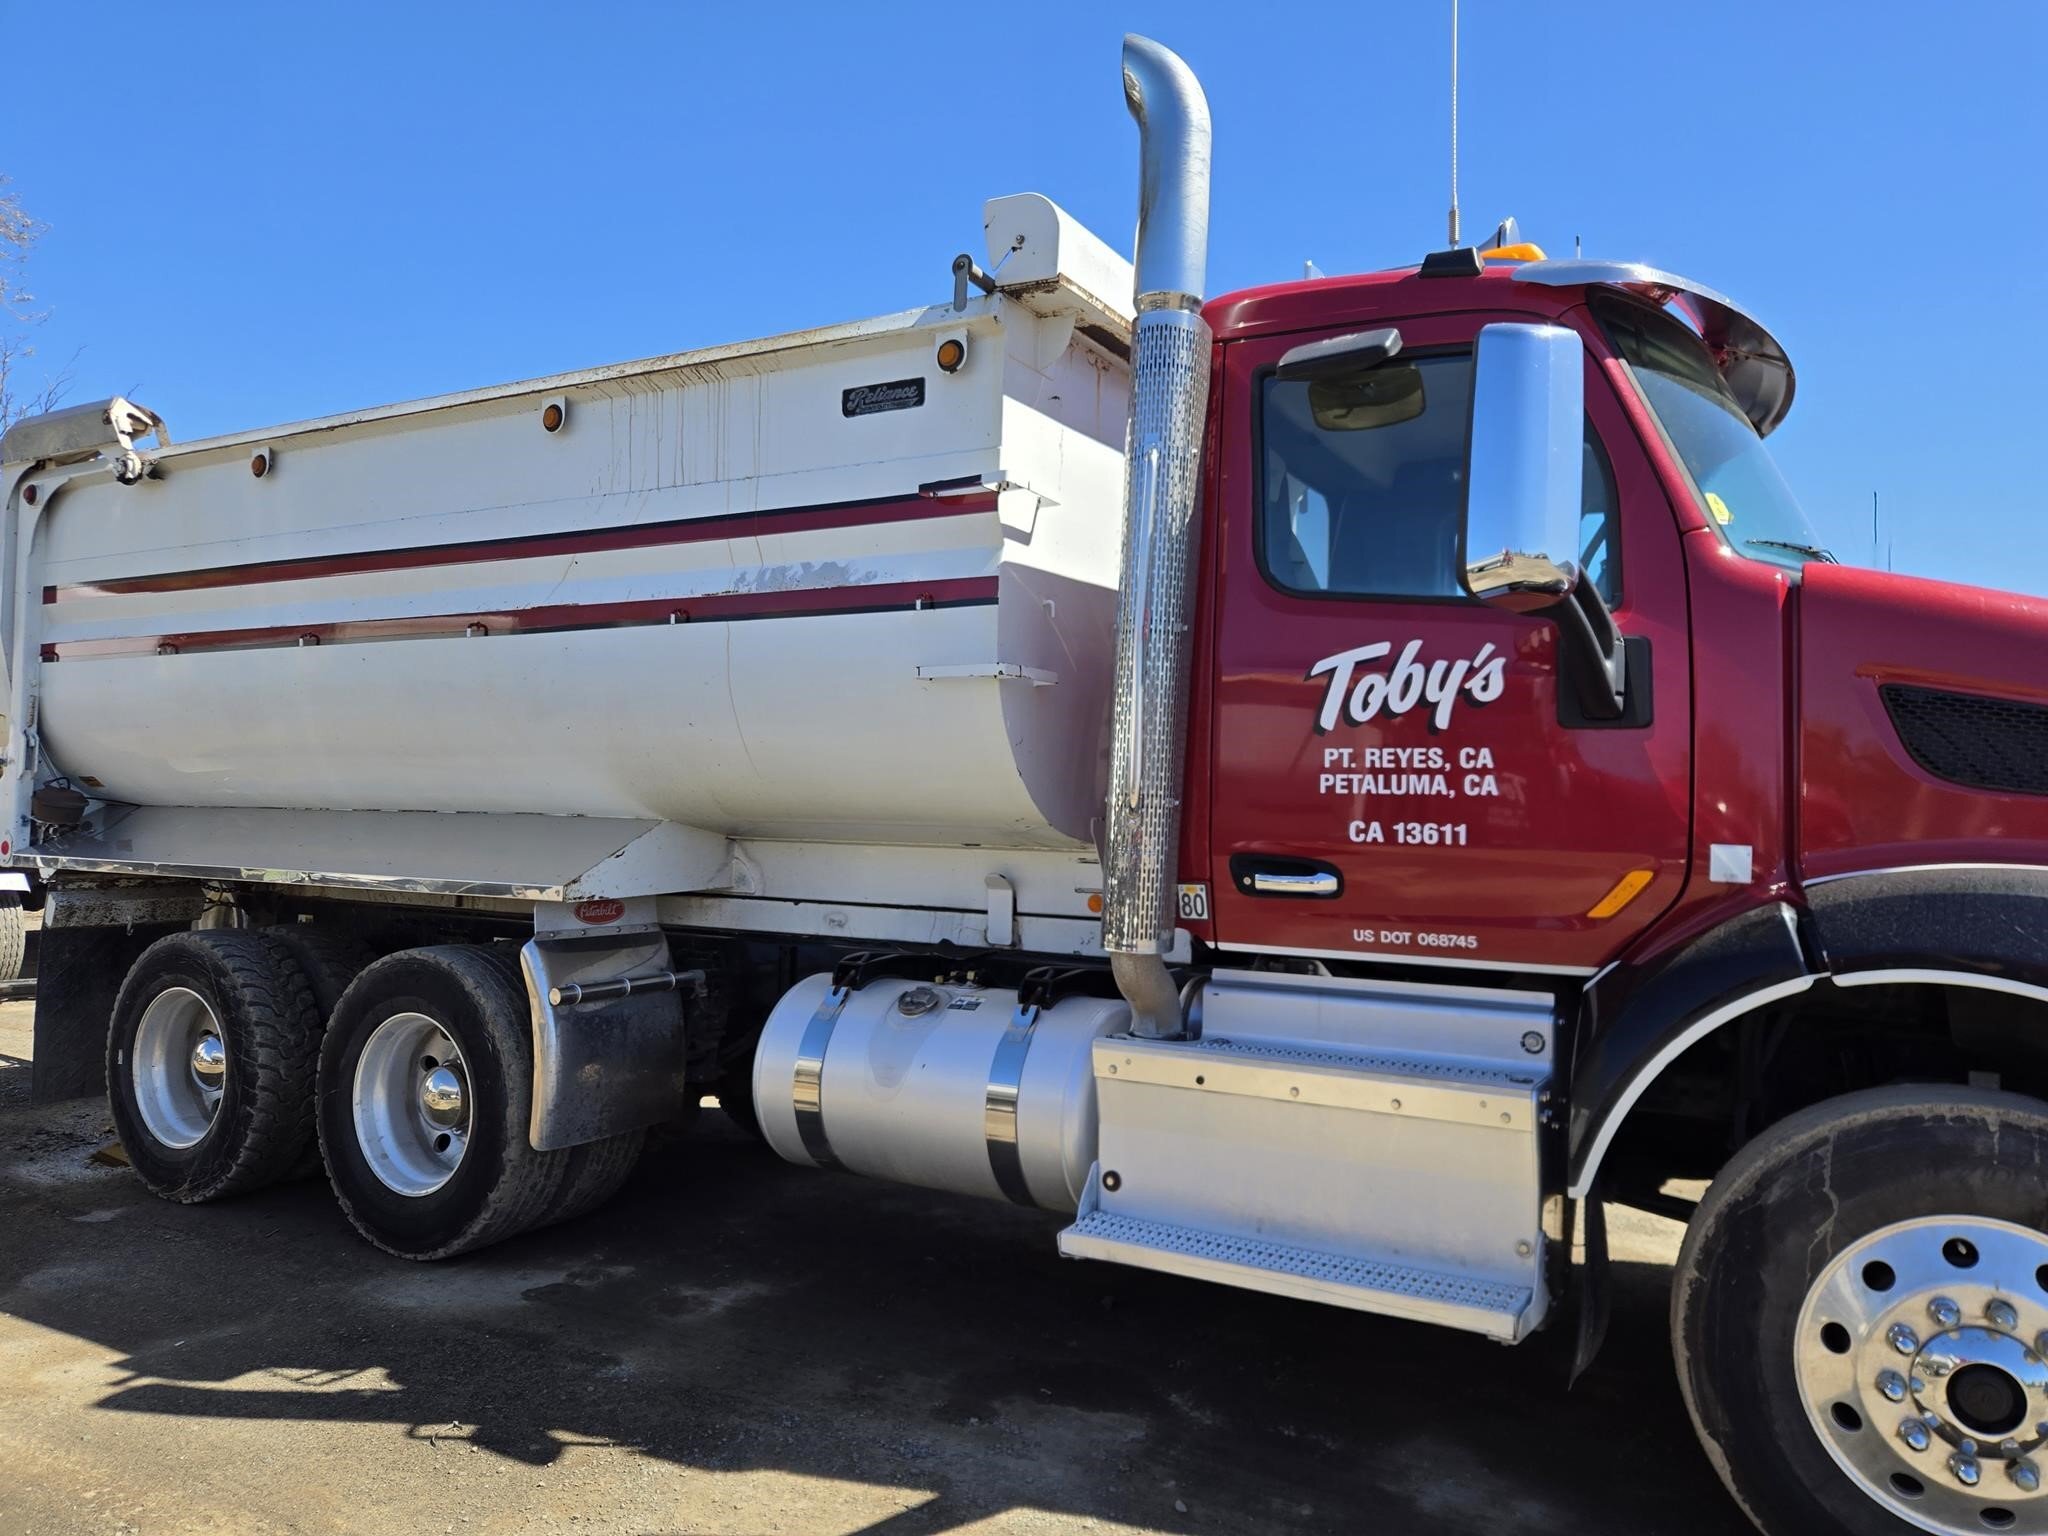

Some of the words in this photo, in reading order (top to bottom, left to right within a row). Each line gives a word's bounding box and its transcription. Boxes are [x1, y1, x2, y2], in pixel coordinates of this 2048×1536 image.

[847, 385, 919, 411] Reliance
[1310, 639, 1507, 732] Toby's
[1324, 747, 1357, 769] PT.
[1365, 747, 1452, 772] REYES,
[1459, 747, 1494, 769] CA
[1319, 773, 1456, 799] PETALUMA,
[1463, 774, 1500, 796] CA
[1348, 820, 1385, 843] CA
[1392, 821, 1468, 846] 13611
[580, 902, 620, 918] Peterbilt
[1181, 892, 1206, 918] 80
[1353, 928, 1375, 942] US
[1380, 930, 1412, 944] DOT
[1417, 932, 1478, 949] 068745
